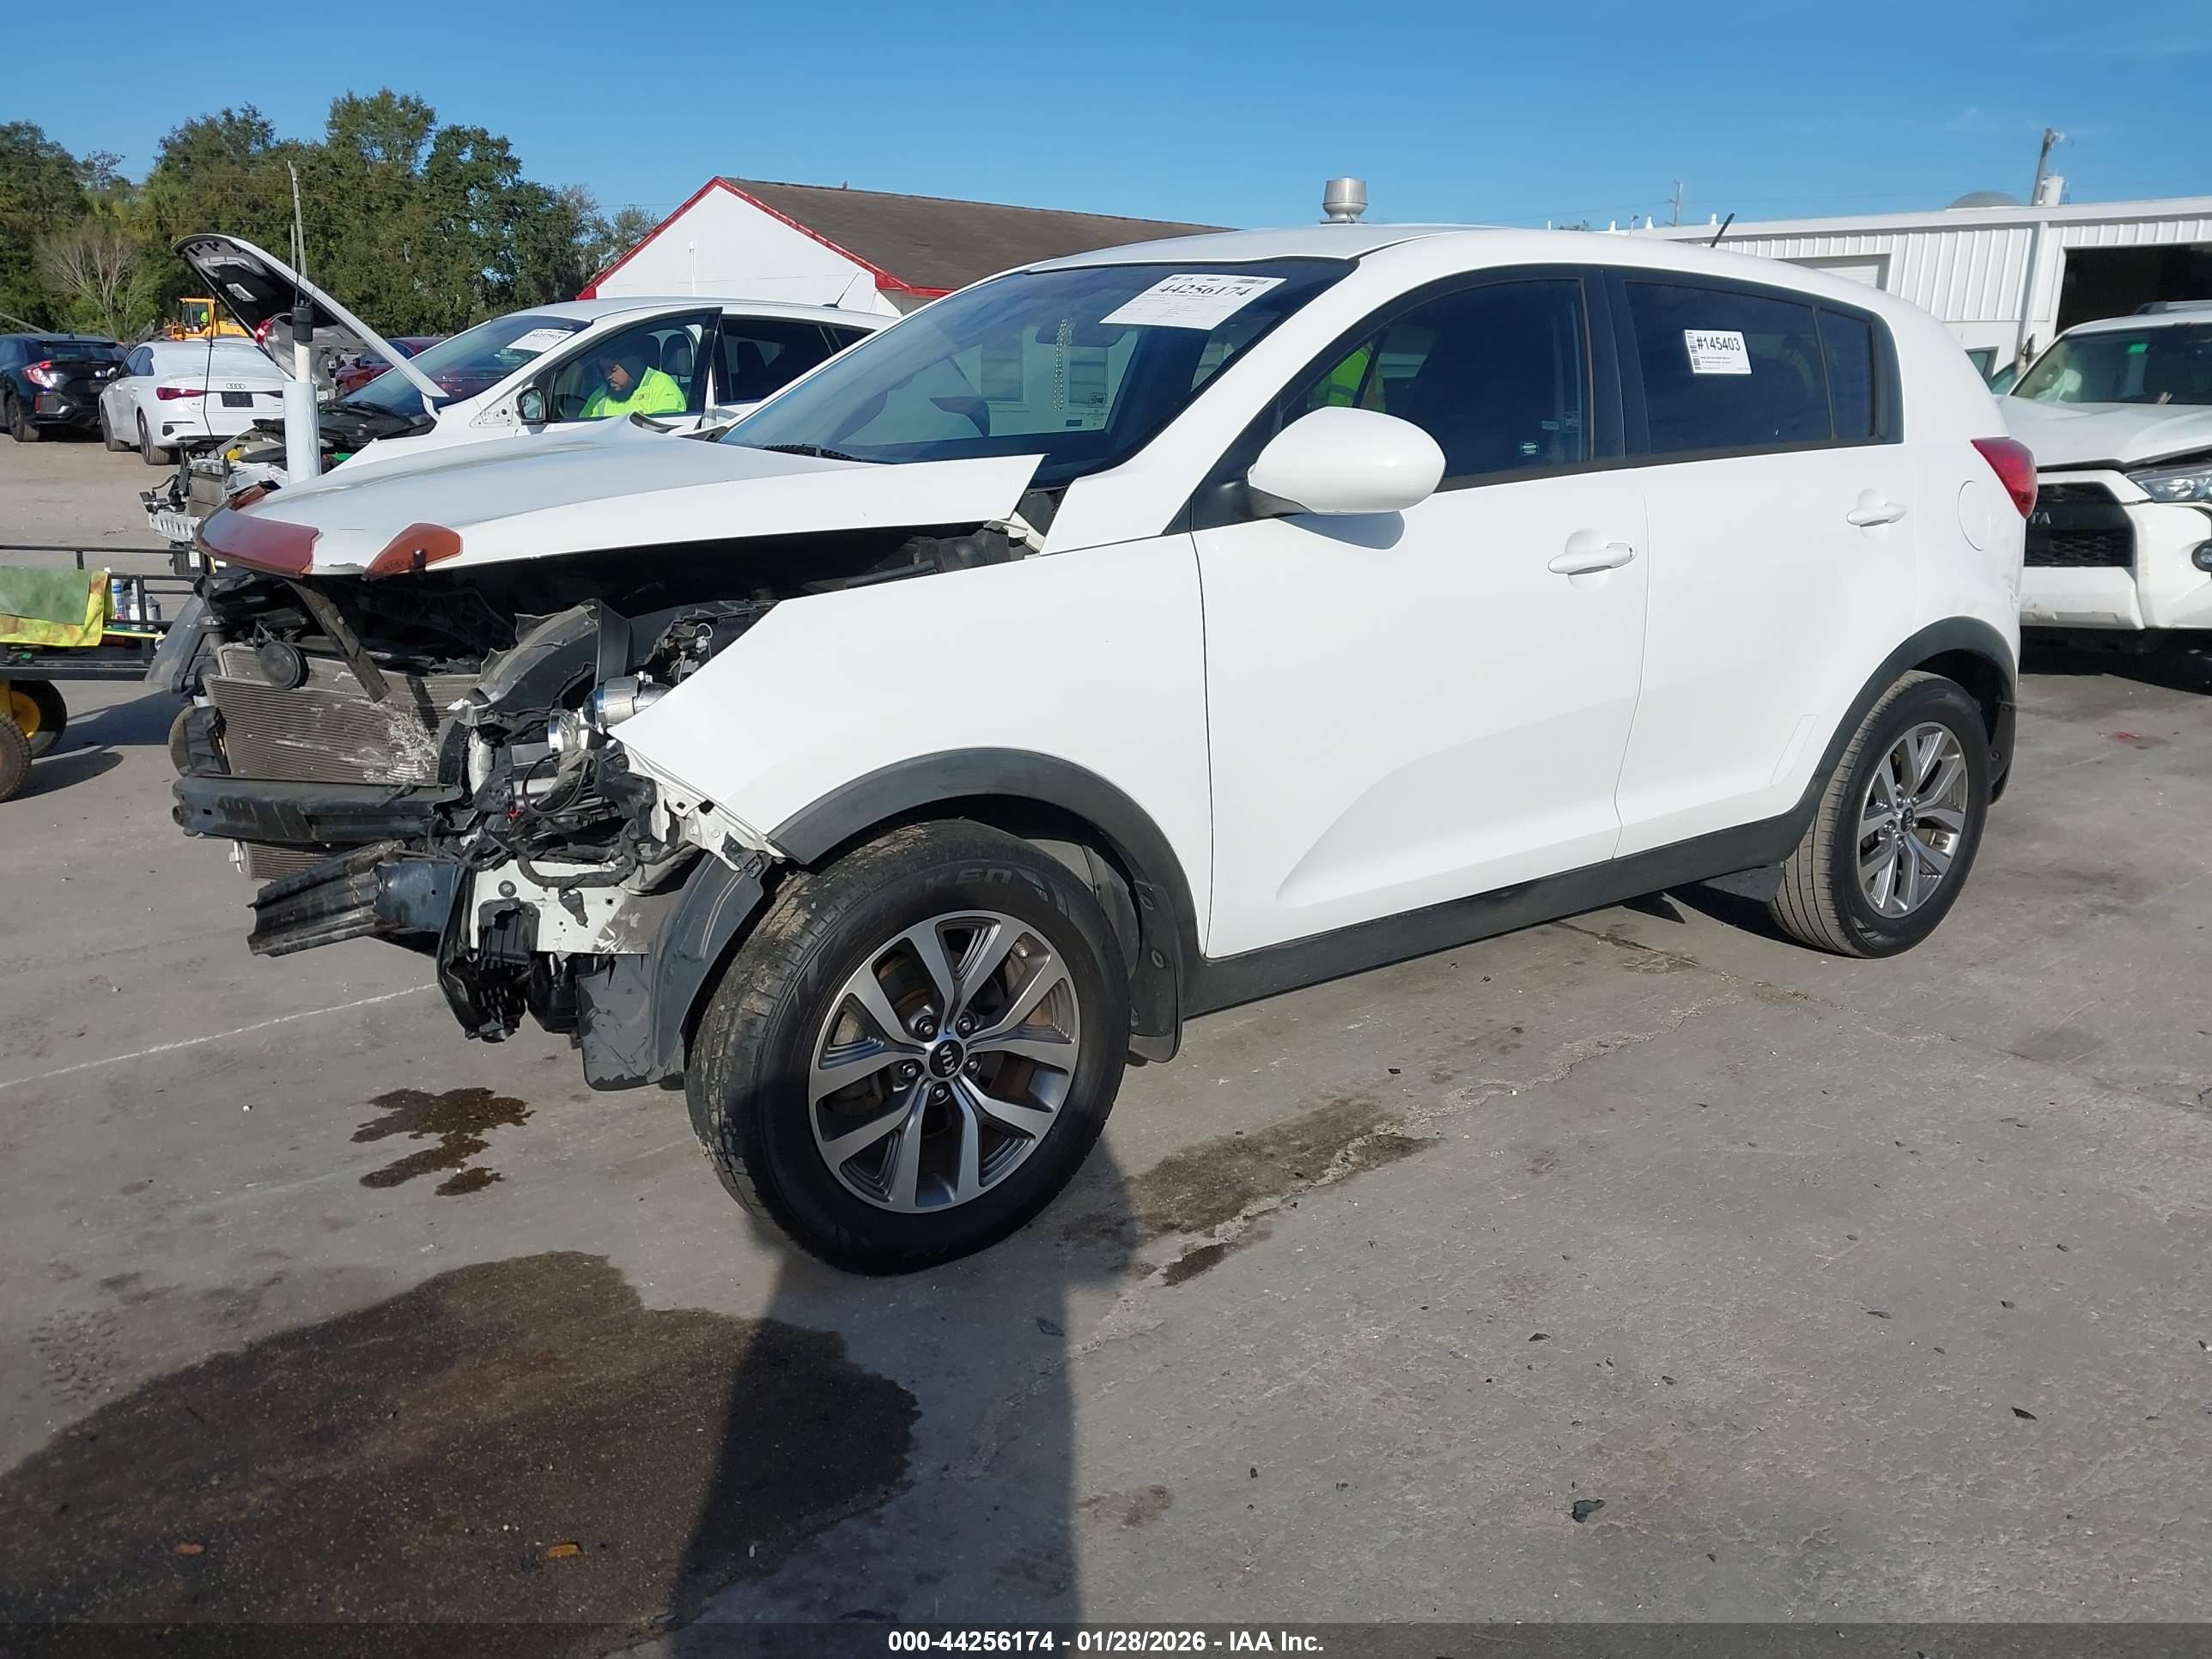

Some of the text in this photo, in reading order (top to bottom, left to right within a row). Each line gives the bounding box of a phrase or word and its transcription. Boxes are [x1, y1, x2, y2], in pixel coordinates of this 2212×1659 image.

[1158, 283, 1253, 297] 44256174
[1696, 336, 1741, 351] #145403
[939, 1043, 956, 1075] KIA
